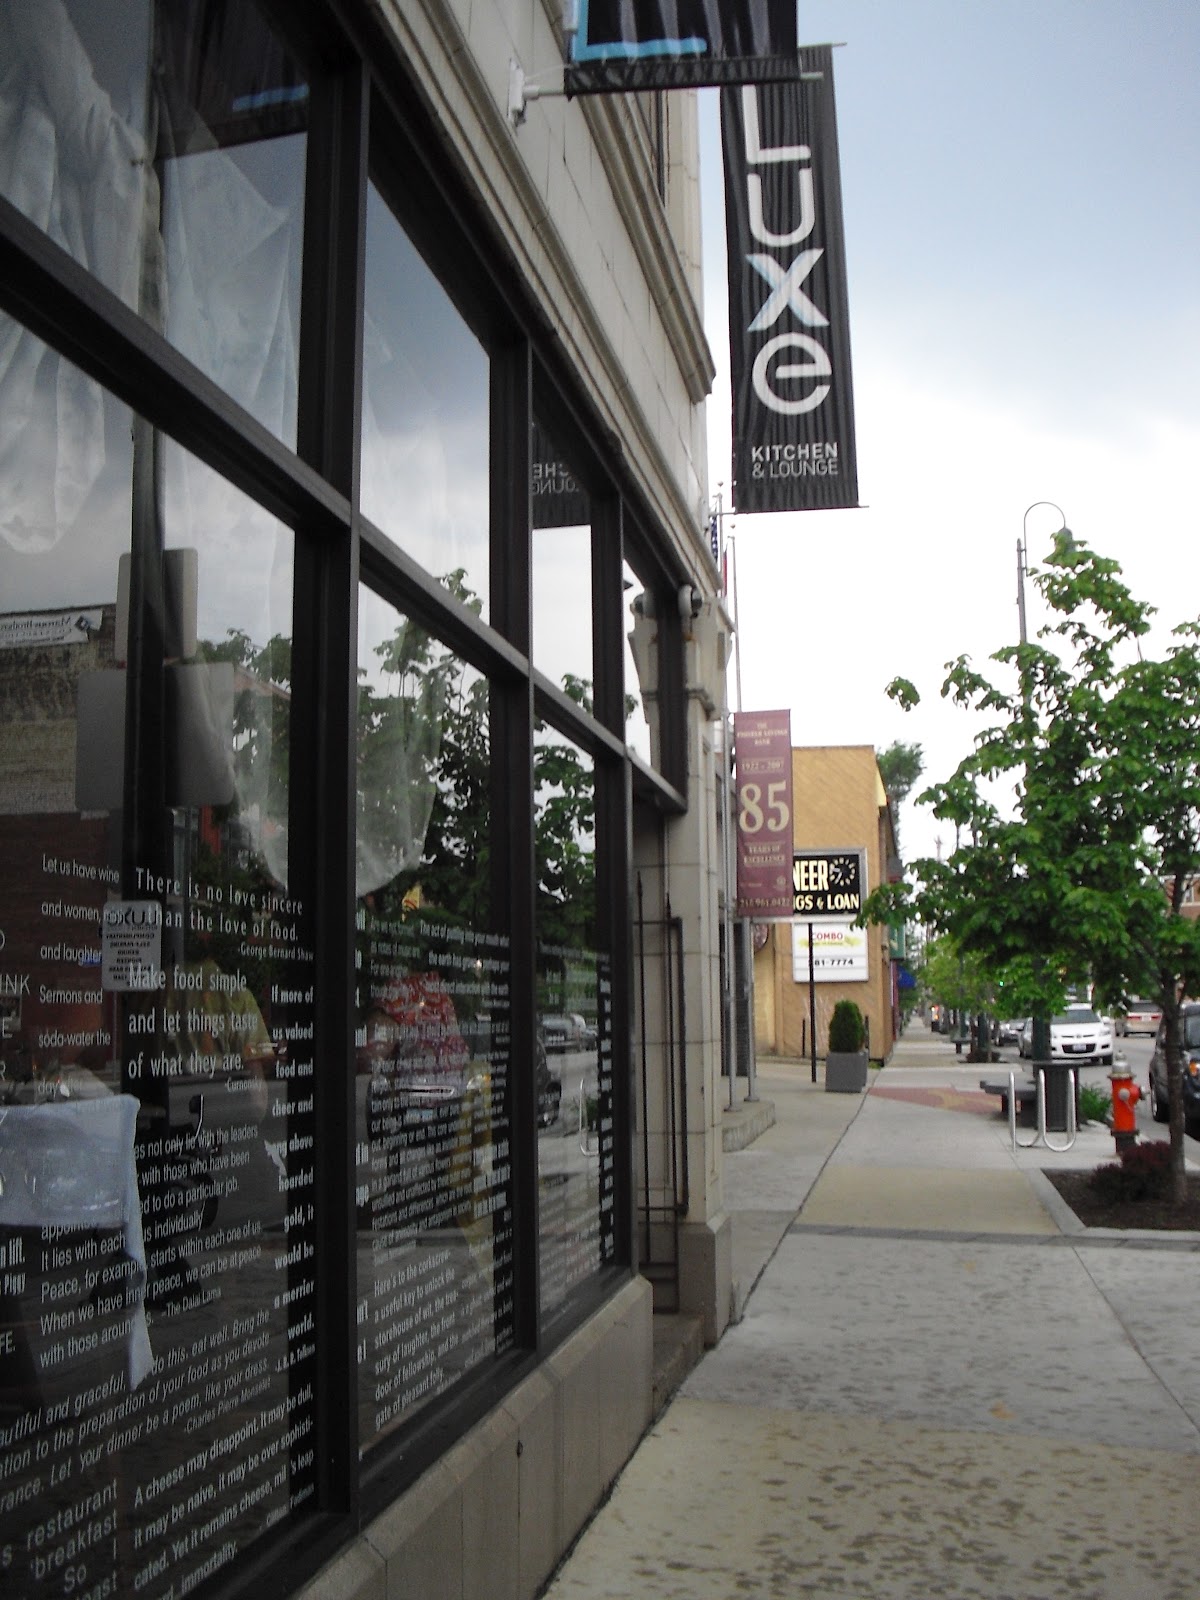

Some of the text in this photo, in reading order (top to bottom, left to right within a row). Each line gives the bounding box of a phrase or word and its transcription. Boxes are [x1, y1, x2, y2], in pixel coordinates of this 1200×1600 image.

[751, 441, 839, 461] KITCHEN
[752, 459, 839, 478] & LOUNGE
[739, 780, 790, 833] 85
[41, 852, 120, 884] Let us have wine
[136, 867, 303, 916] There no love sincere
[827, 893, 860, 911] LOAN
[40, 898, 62, 917] and
[63, 904, 101, 924] women,
[190, 904, 298, 942] the love of food.
[40, 942, 61, 961] and
[40, 984, 103, 1005] Sermons and
[129, 962, 247, 997] Make food simple
[271, 984, 314, 1004] If more of
[128, 1006, 258, 1039] and let things taste
[272, 1021, 314, 1040] us valued
[38, 1028, 111, 1048] soda-water the
[128, 1050, 244, 1080] of what they are.
[275, 1057, 314, 1079] food and
[272, 1093, 314, 1118] cheer and
[148, 1138, 162, 1157] not
[165, 1134, 184, 1157] only
[216, 1127, 229, 1145] the
[230, 1124, 259, 1143] leaders
[288, 1133, 314, 1152] above
[141, 1151, 250, 1187] with those who have been
[279, 1166, 314, 1192] hoarded
[152, 1194, 162, 1213] to
[163, 1190, 176, 1209] do
[178, 1190, 184, 1206] a
[186, 1179, 224, 1208] particular
[283, 1207, 305, 1234] gold,
[41, 1230, 126, 1273] It lies with each
[41, 1219, 251, 1305] Peace, for starts within each one of
[274, 1241, 314, 1271] would be
[40, 1244, 262, 1337] When we have peace, we can be peace
[282, 1278, 315, 1307] merrier
[374, 1264, 417, 1298] Here's the
[182, 1293, 201, 1313] Dalai
[381, 1290, 416, 1320] useful key
[287, 1312, 315, 1340] world.
[375, 1315, 413, 1350] storehouse
[40, 1332, 98, 1369] with those
[375, 1354, 391, 1376] sury
[46, 1396, 70, 1425] and
[192, 1334, 207, 1357] eat
[233, 1316, 255, 1339] Bring
[256, 1309, 270, 1327] the
[36, 1332, 270, 1461] to the preparation of your food as you devote
[375, 1379, 392, 1402] door
[50, 1370, 244, 1488] Let your dinner be a like your
[375, 1405, 391, 1430] gate
[134, 1396, 296, 1510] A cheese may may be
[145, 1440, 279, 1543] may be may be over
[171, 1535, 189, 1562] Yet
[200, 1503, 239, 1542] remains
[298, 1448, 314, 1470] leap
[27, 1477, 118, 1552] restaurant
[64, 1563, 87, 1593] So
